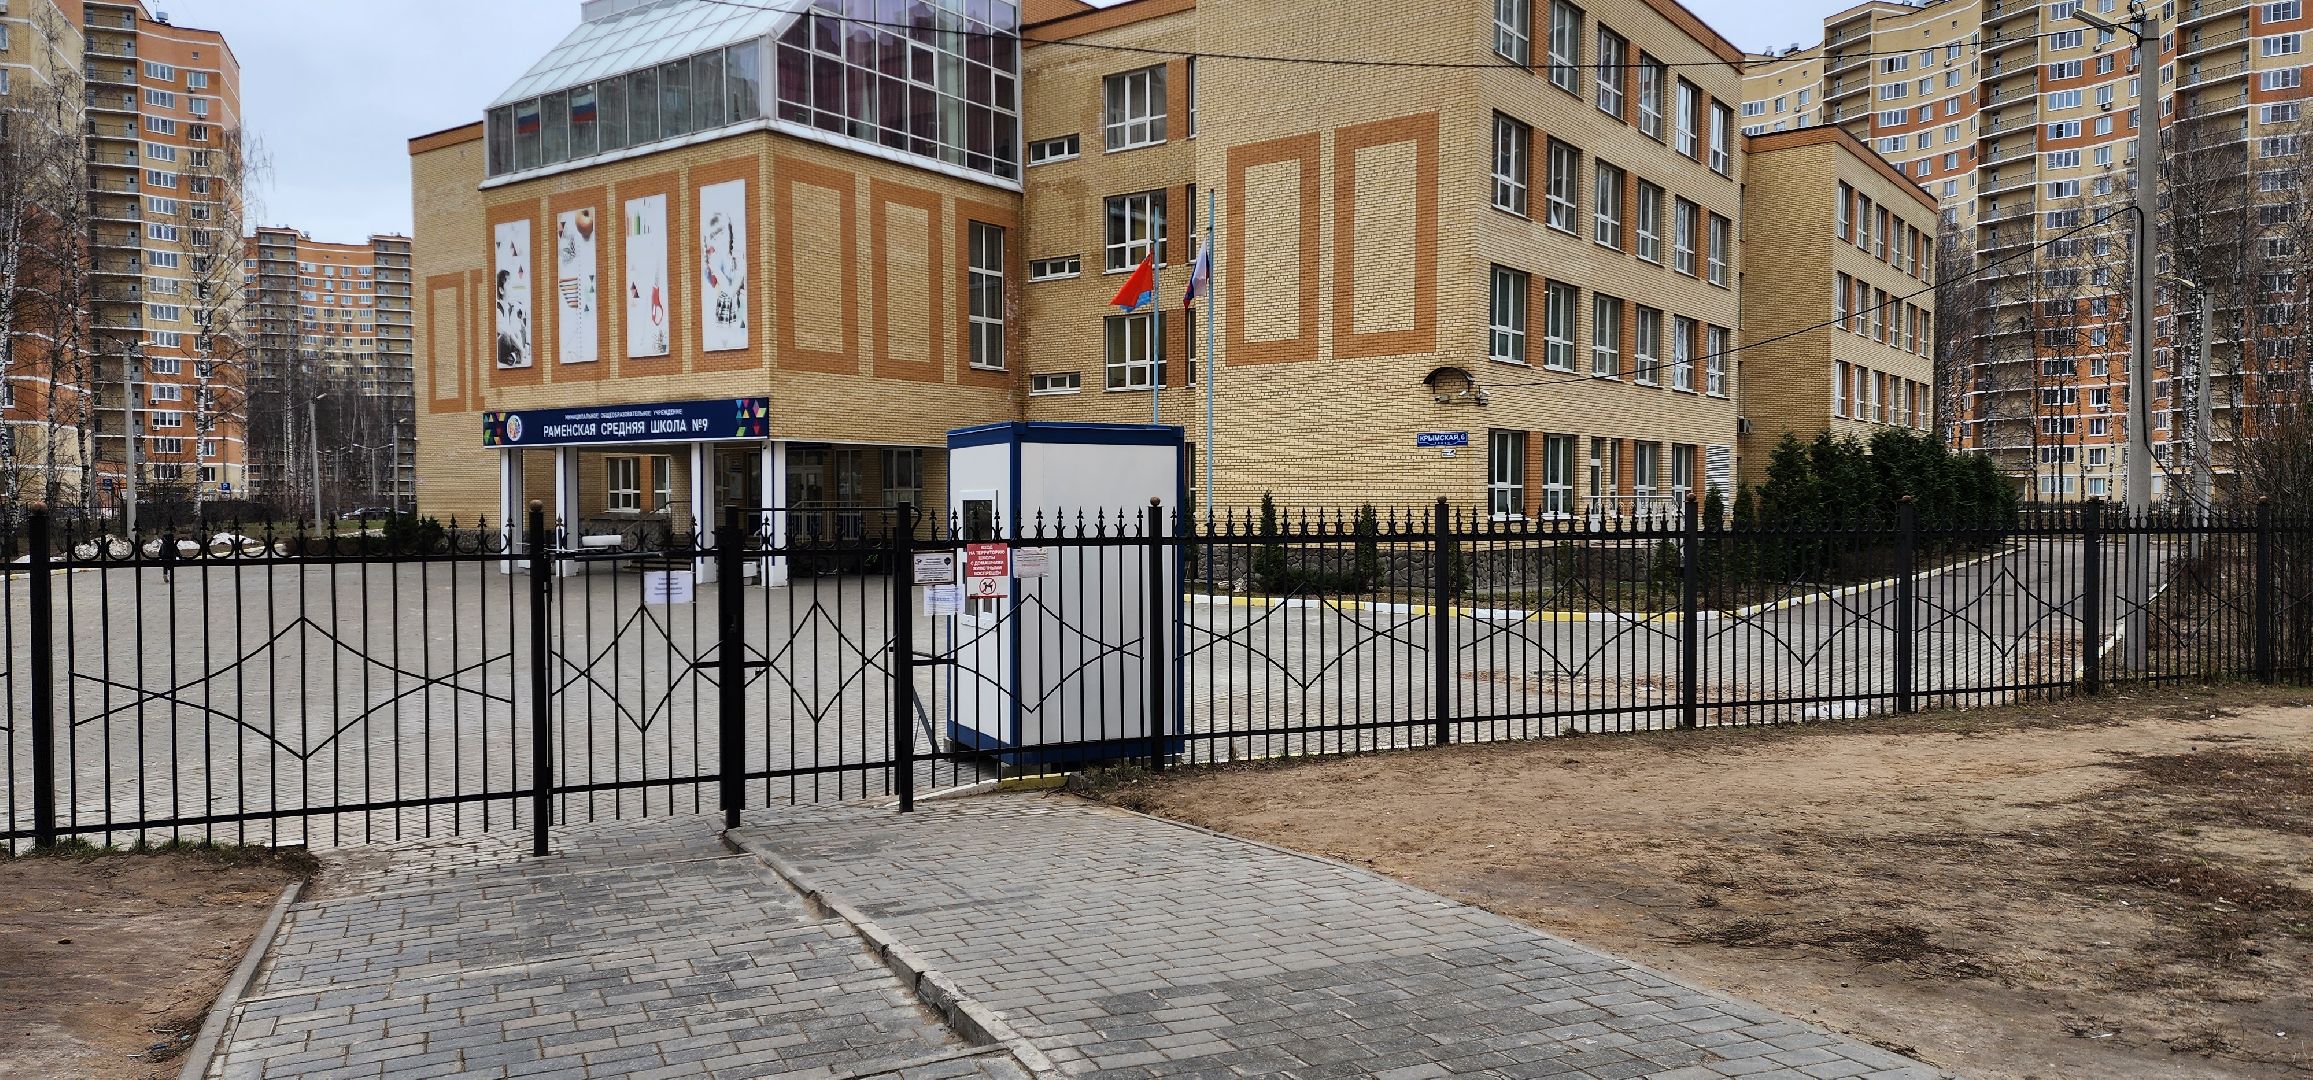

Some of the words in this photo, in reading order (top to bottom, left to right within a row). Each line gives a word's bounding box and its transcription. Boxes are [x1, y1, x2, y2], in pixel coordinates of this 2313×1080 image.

[601, 411, 652, 419] ОБЩЕОБРАЗОВАТЕЛЬНОЕ
[543, 423, 596, 438] РАМЕНСКАЯ
[600, 421, 645, 437] СРЕДНЯЯ
[650, 419, 687, 434] ШКОЛА
[692, 418, 708, 432] №9
